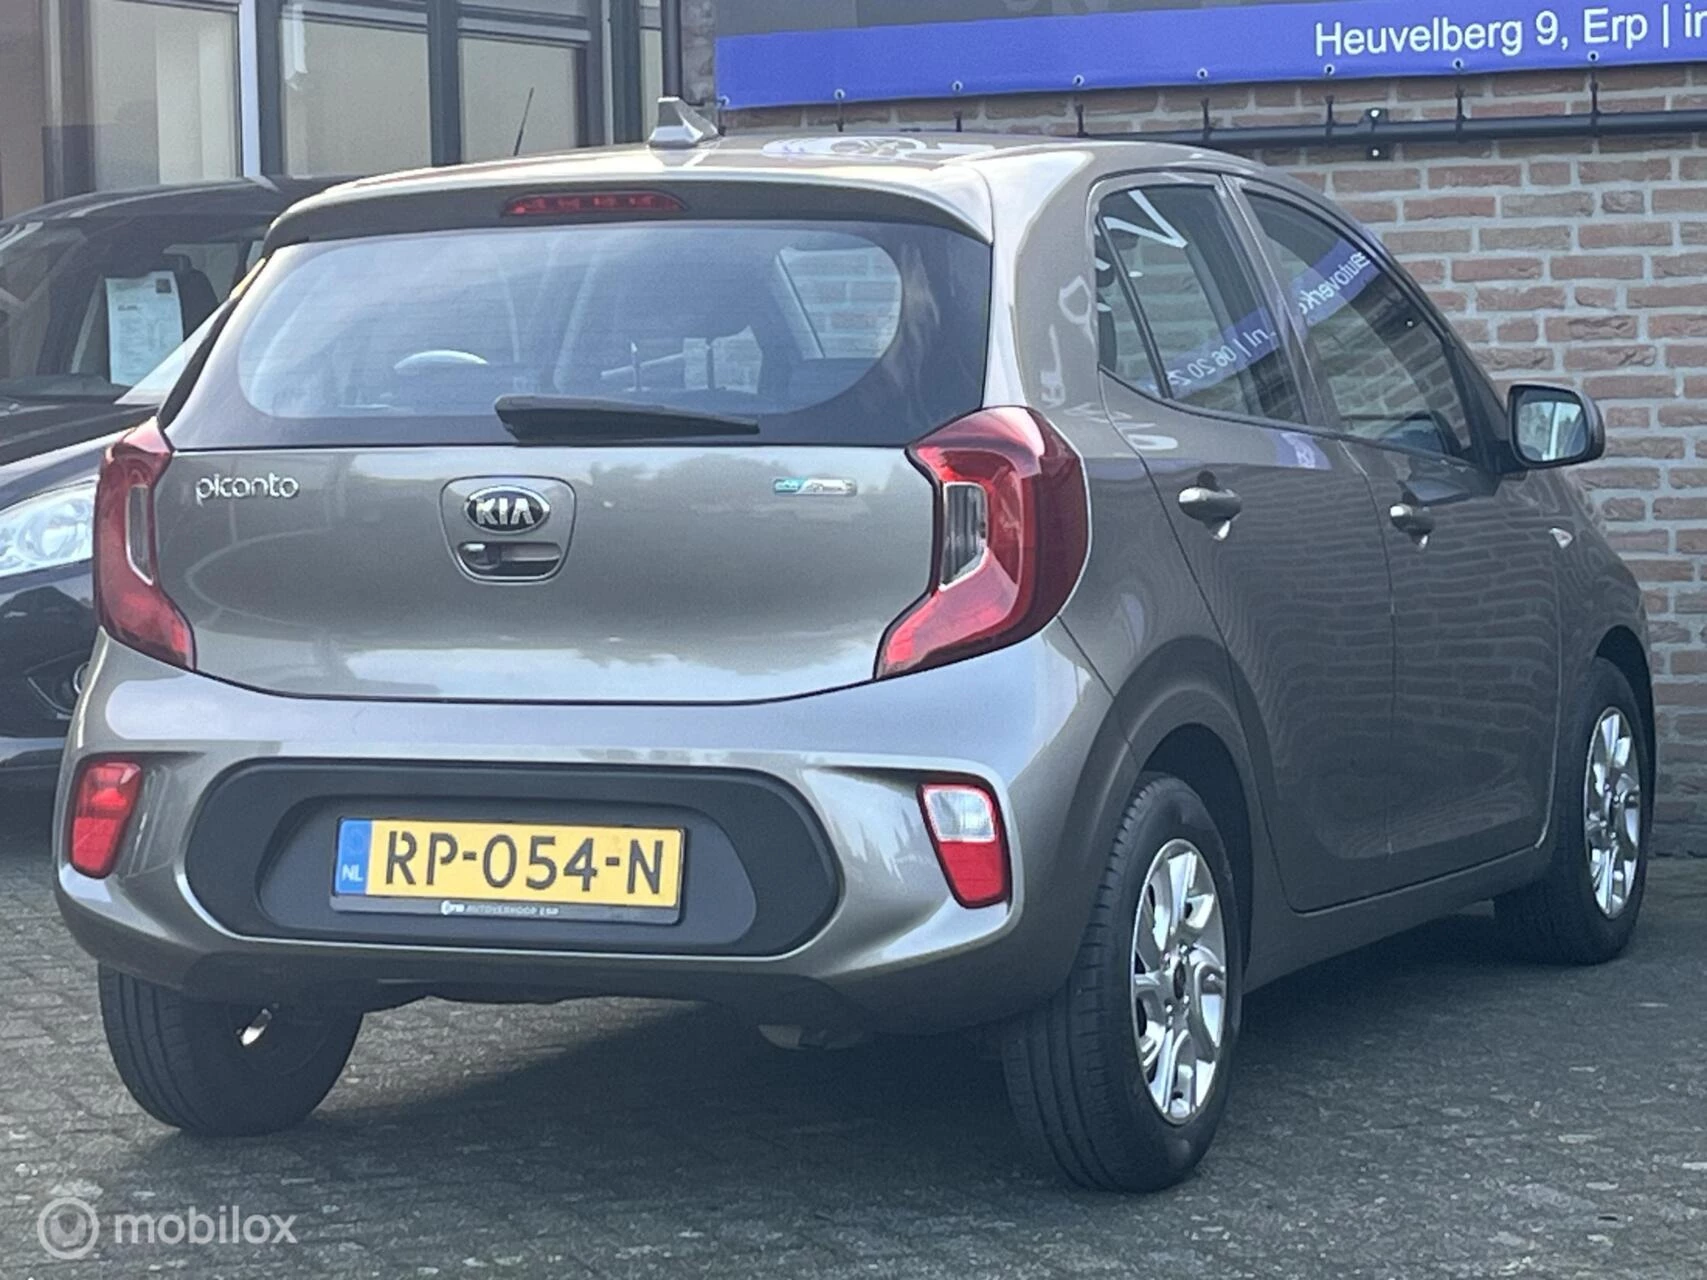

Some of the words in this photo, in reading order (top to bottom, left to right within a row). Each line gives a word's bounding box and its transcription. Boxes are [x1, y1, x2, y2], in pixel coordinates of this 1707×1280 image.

[1315, 17, 1523, 56] Heuvelberg
[1535, 10, 1569, 51] 9,
[1583, 8, 1648, 50] Erp
[195, 472, 299, 507] picanto
[476, 498, 534, 525] KIA
[341, 864, 364, 882] NL
[385, 830, 664, 895] RP-054-N
